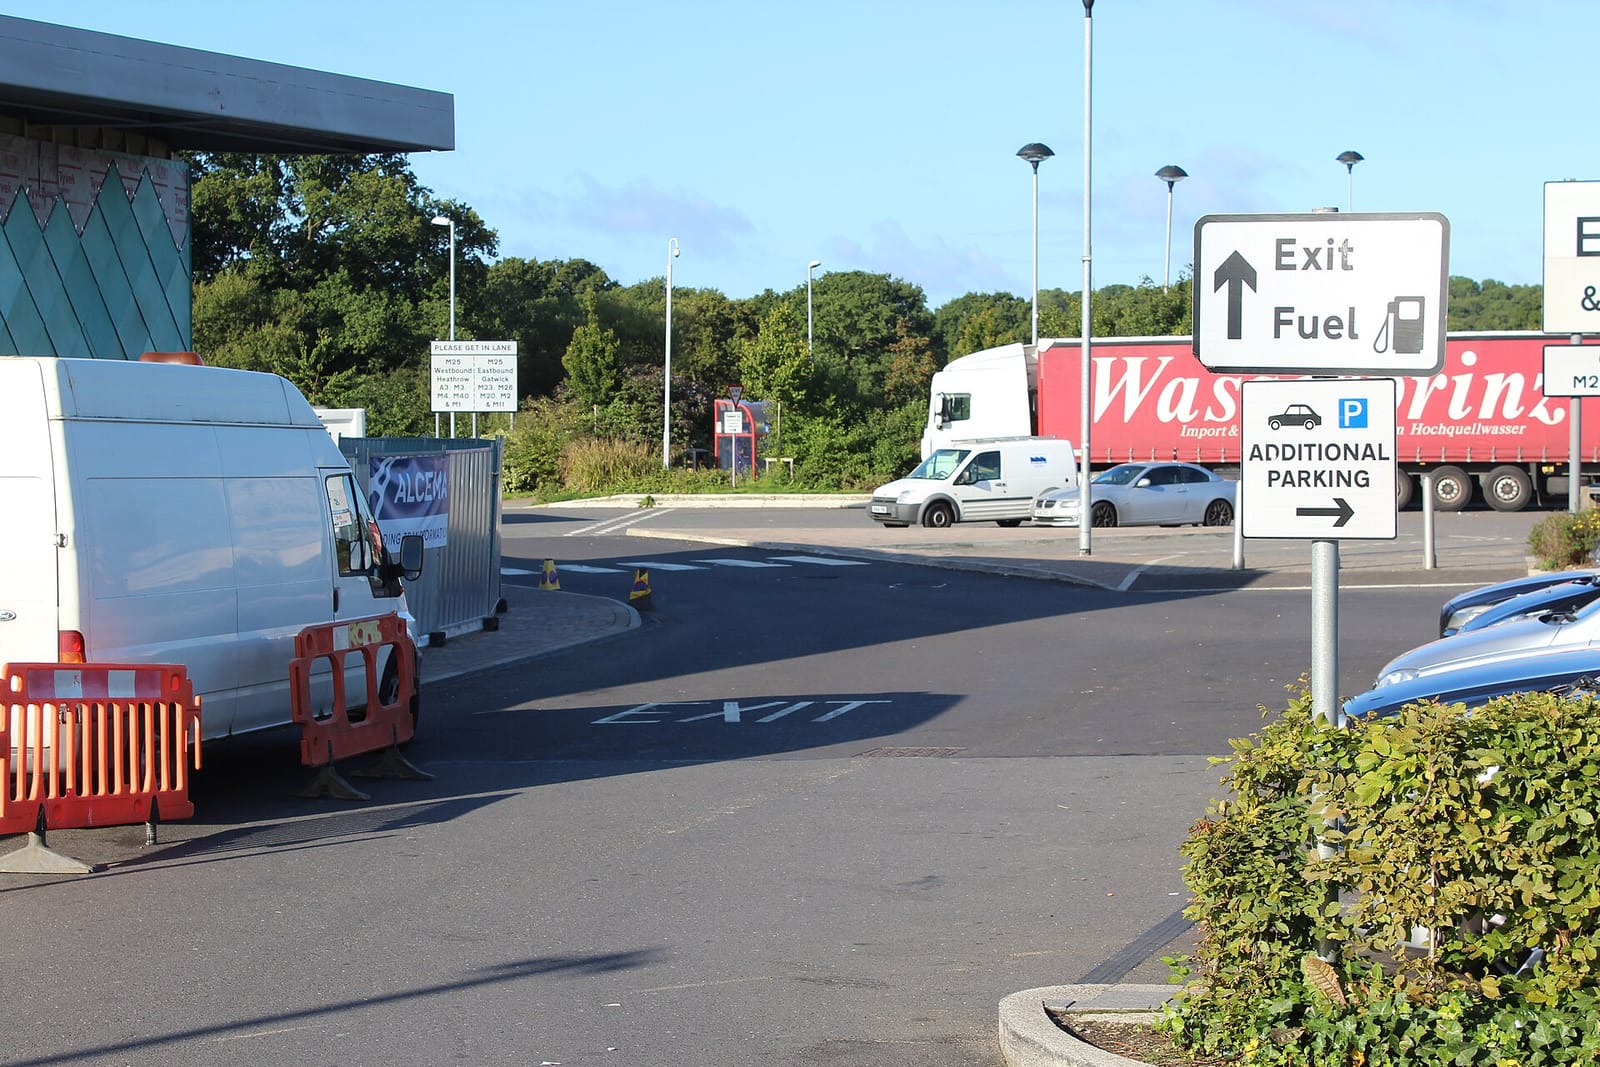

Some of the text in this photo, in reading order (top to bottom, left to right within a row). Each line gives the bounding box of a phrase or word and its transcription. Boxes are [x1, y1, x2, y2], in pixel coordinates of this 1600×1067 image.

[1275, 238, 1354, 271] Exit
[1273, 306, 1359, 340] Fuel
[1344, 401, 1362, 427] P
[1181, 424, 1226, 439] Import
[1228, 424, 1239, 437] &
[1410, 422, 1527, 438] Hochquellwasser
[1249, 443, 1390, 461] ADDITIONAL
[394, 471, 448, 504] ALCEMA
[1268, 469, 1370, 488] PARKING
[590, 700, 893, 724] EXIT
